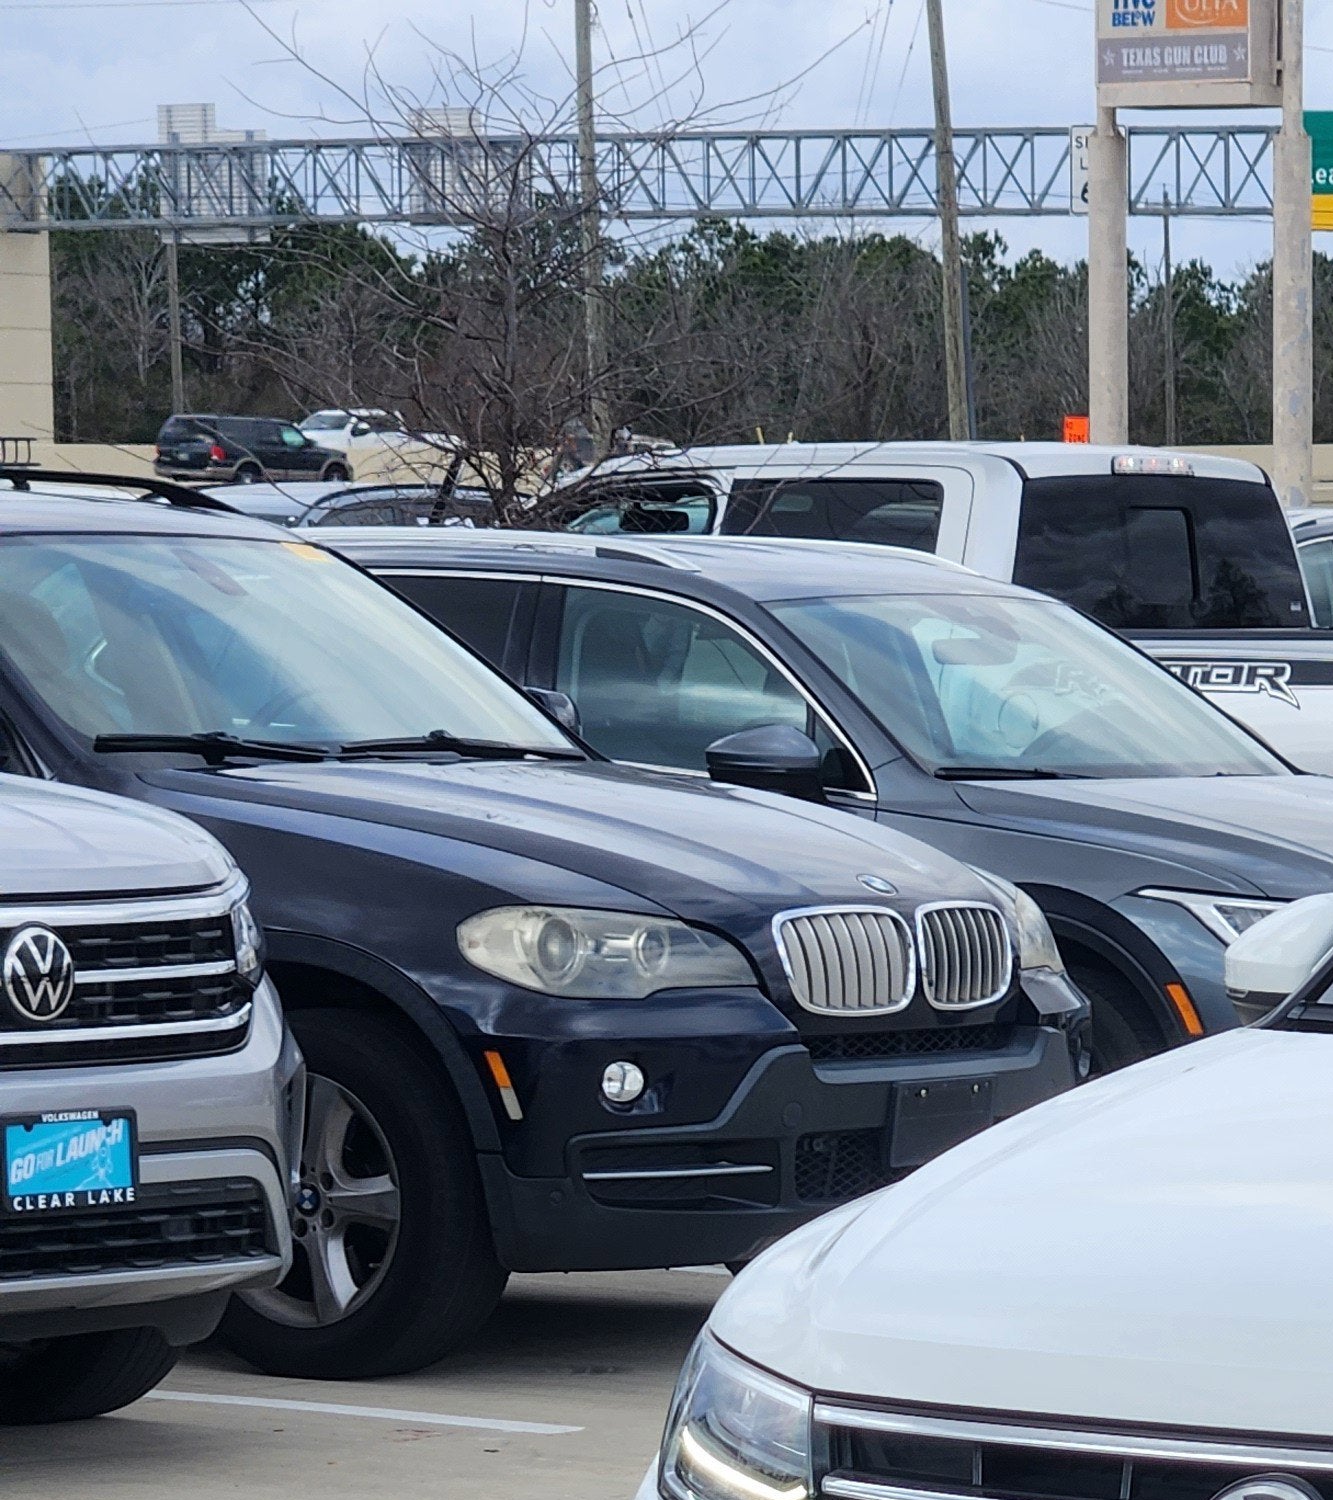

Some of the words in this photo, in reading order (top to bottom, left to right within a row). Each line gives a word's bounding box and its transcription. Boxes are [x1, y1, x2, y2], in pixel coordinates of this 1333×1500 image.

[1122, 46, 1161, 67] TEXAS
[1164, 45, 1191, 66] GUN
[1194, 44, 1228, 65] CLUB
[1162, 660, 1301, 711] TOR
[41, 1111, 99, 1123] VOLKSWAGEN
[10, 1152, 36, 1185] GO
[56, 1118, 124, 1167] LAUNCH
[13, 1192, 76, 1211] CLEAR
[87, 1187, 136, 1205] LAKE
